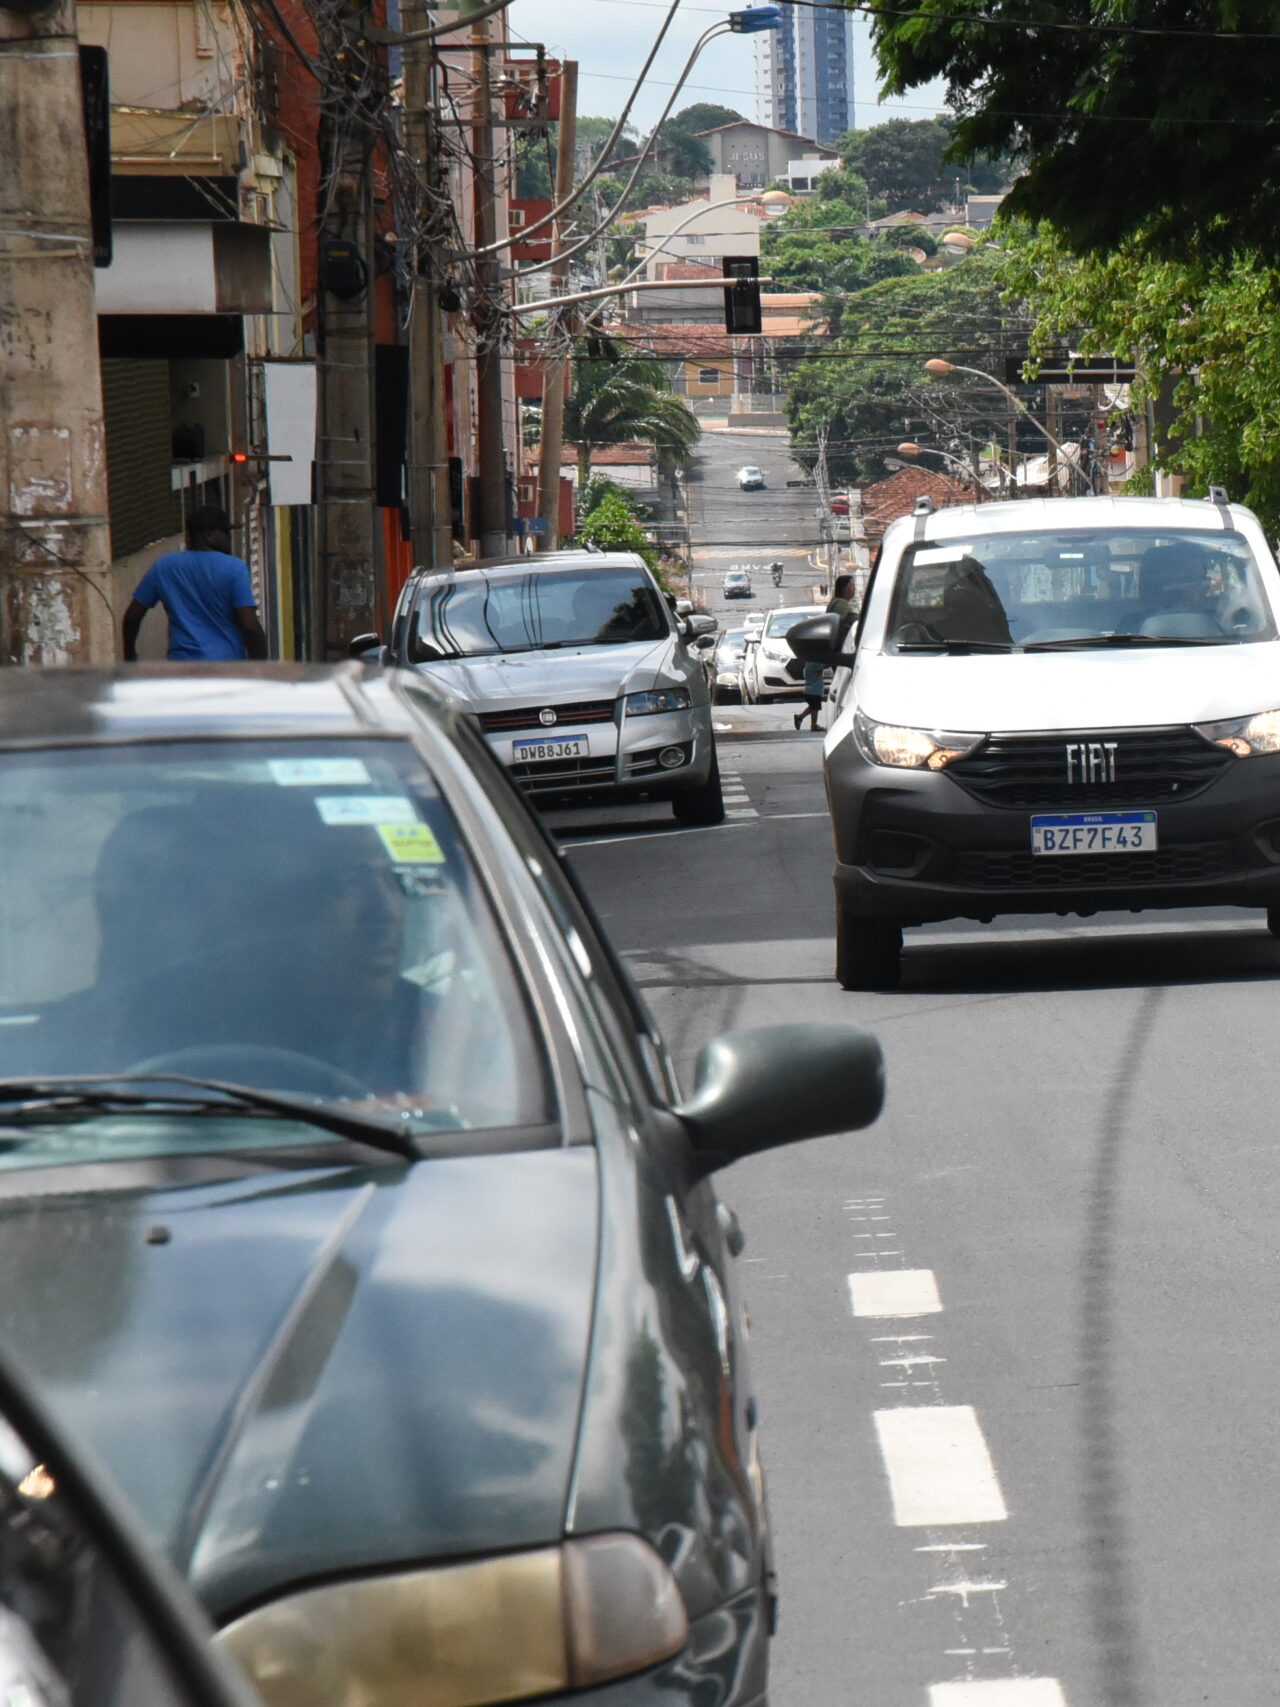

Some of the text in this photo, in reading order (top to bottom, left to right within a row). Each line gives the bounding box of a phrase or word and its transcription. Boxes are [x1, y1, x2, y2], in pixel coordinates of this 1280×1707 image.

[729, 152, 766, 161] JESUS
[520, 742, 581, 760] DWB8J61
[1066, 742, 1118, 784] FIAT
[1043, 826, 1142, 851] BZF7F43
